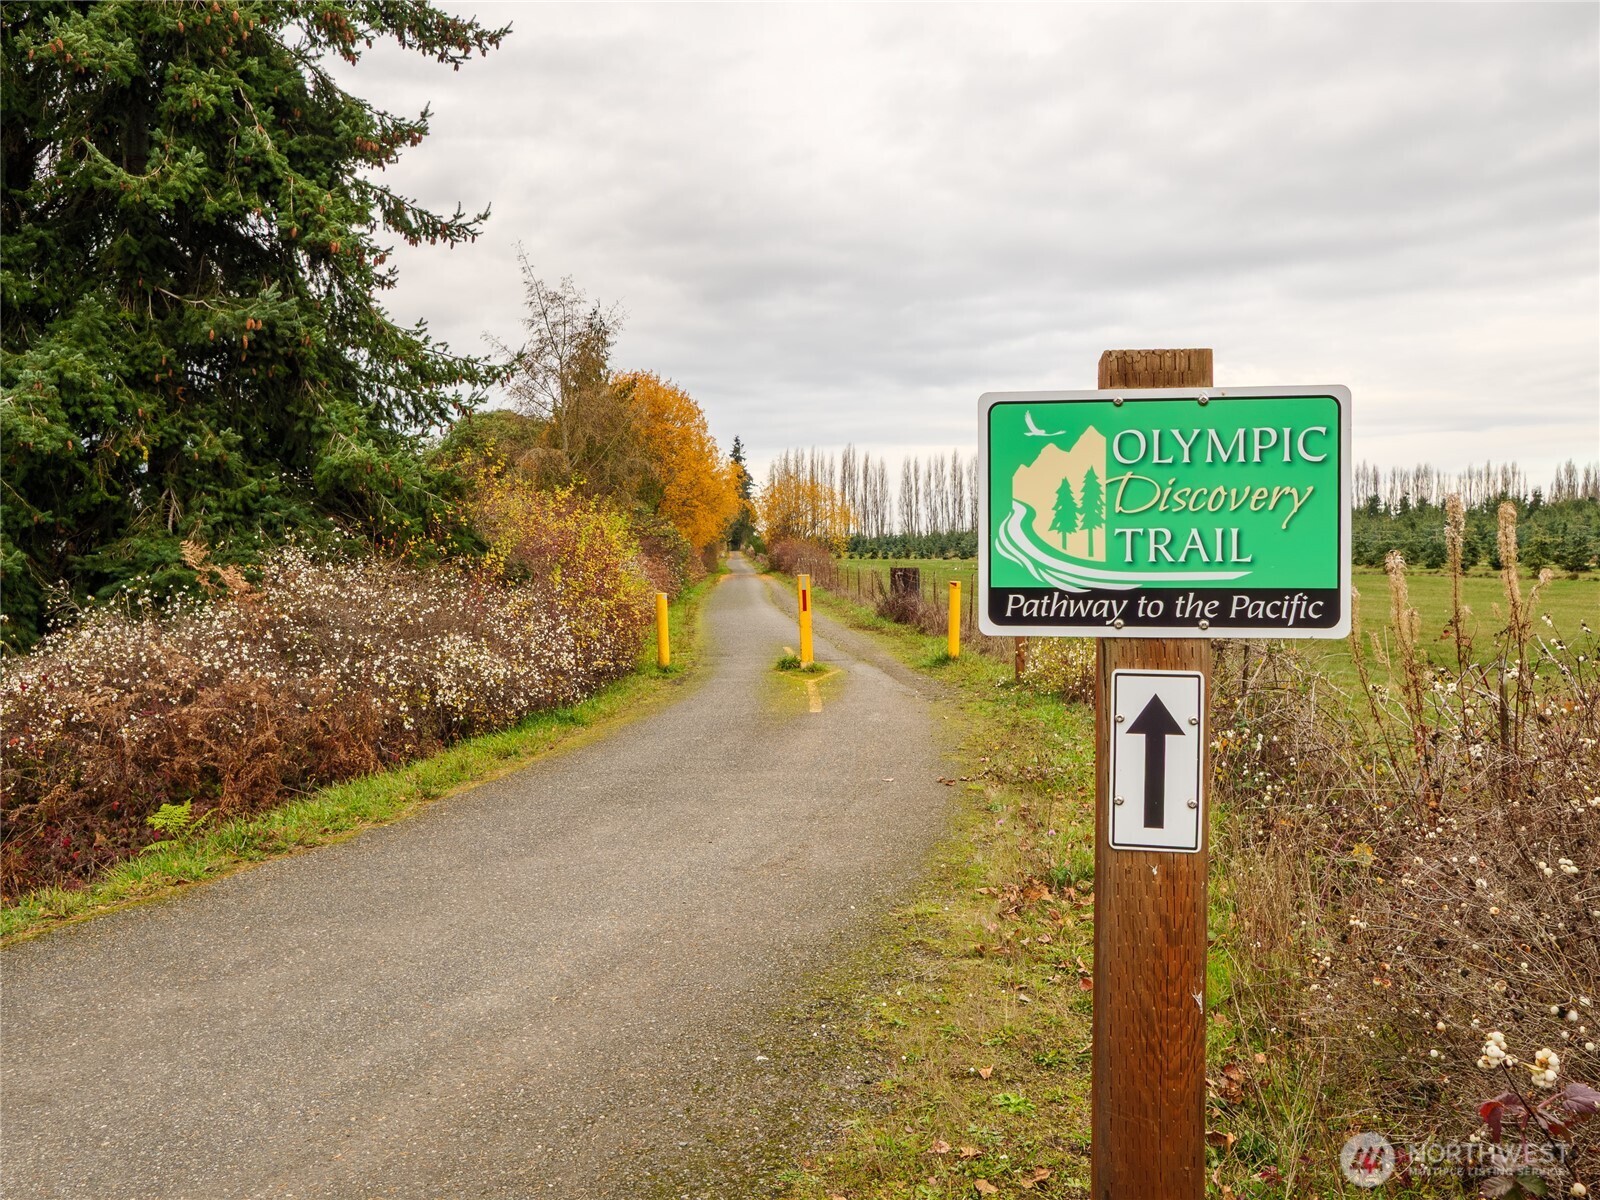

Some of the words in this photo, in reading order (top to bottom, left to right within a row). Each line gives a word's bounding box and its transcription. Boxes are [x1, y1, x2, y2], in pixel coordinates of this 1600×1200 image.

[1112, 426, 1328, 465] OLYMPIC
[1106, 471, 1315, 530] Discovery
[1114, 527, 1253, 563] TRAIL
[1005, 591, 1129, 626] Pathway
[1138, 596, 1165, 619] to
[1175, 592, 1219, 618] the
[1229, 592, 1324, 626] Pacific
